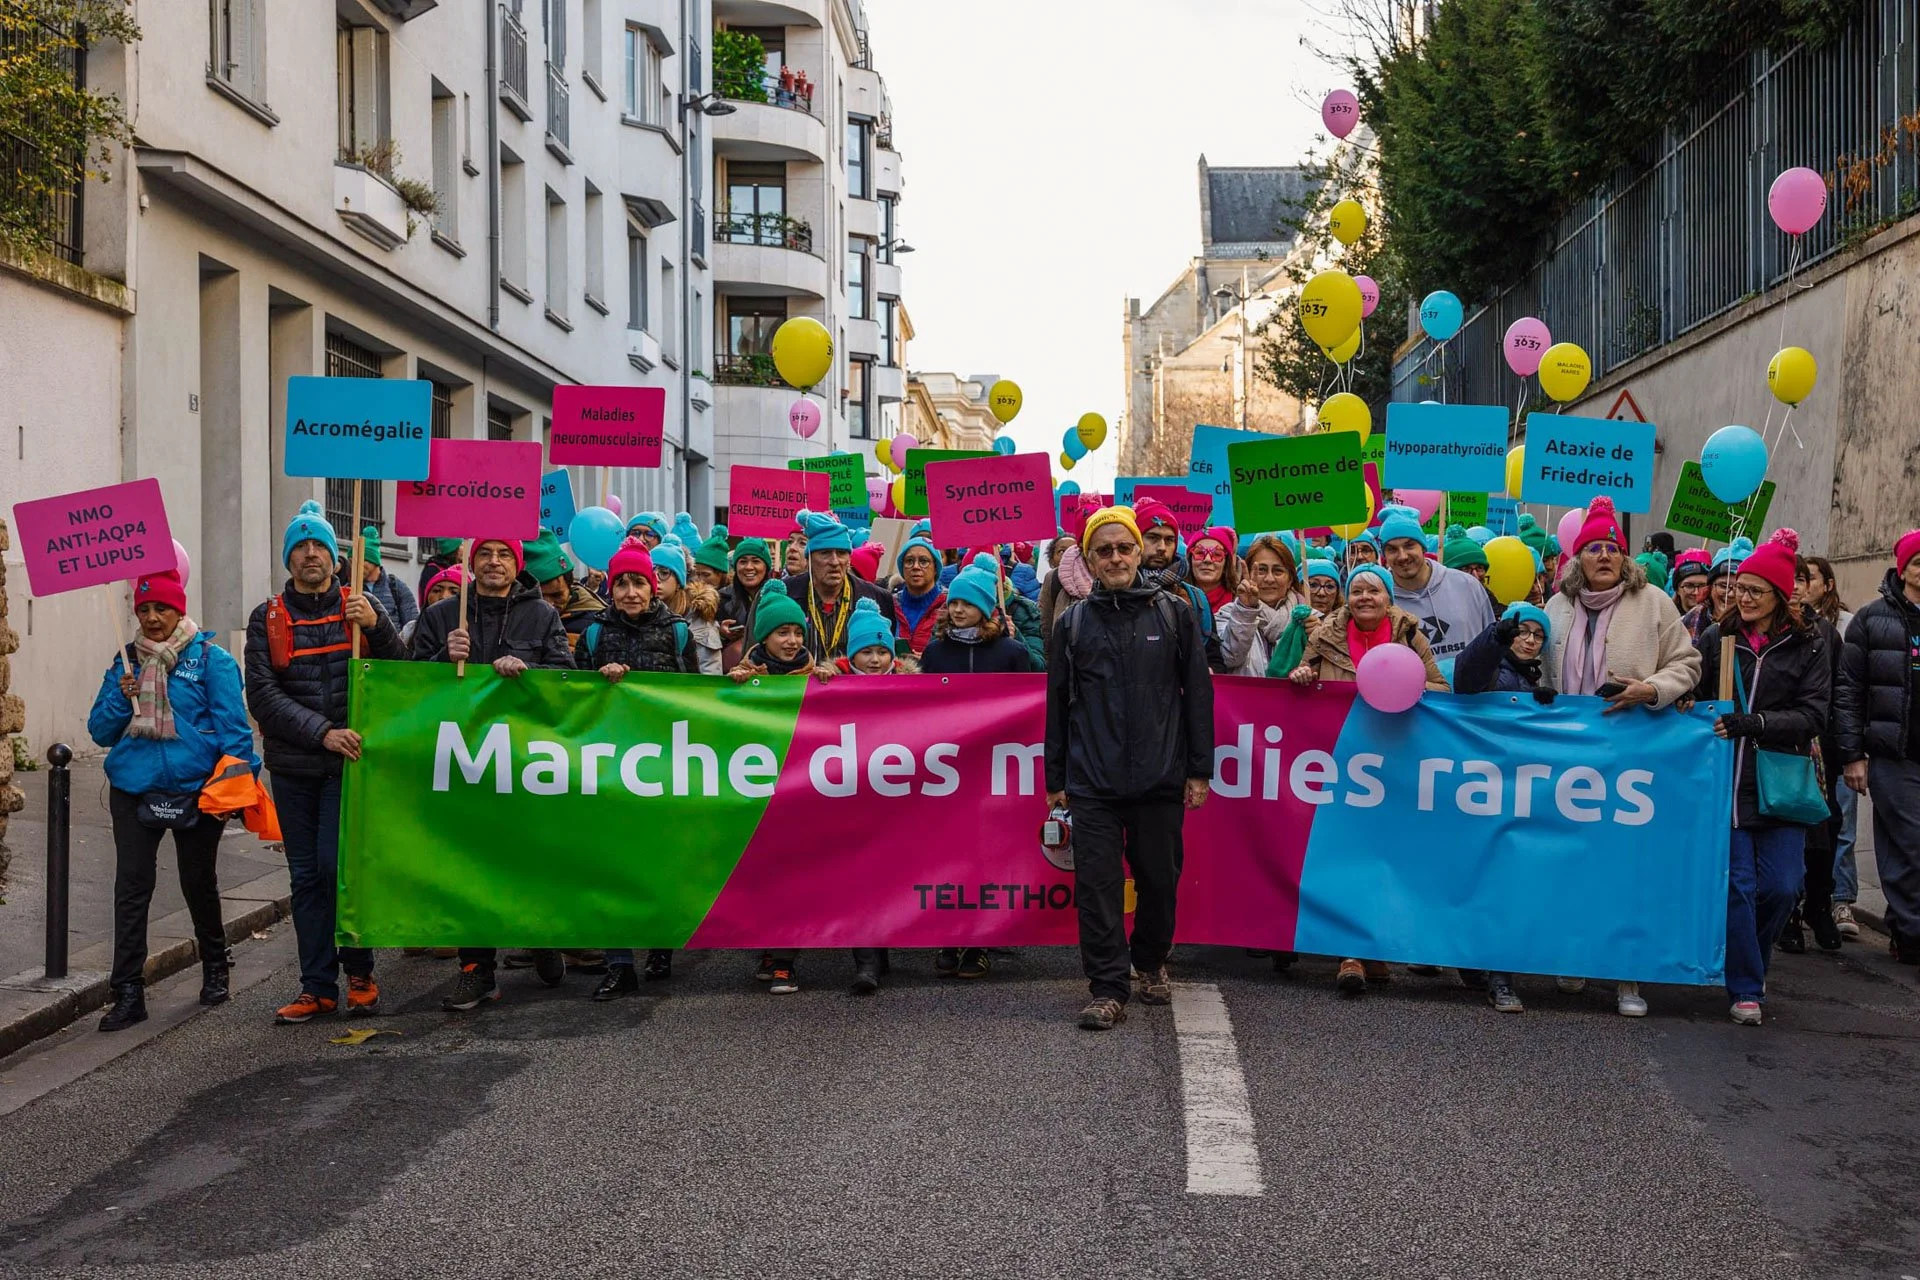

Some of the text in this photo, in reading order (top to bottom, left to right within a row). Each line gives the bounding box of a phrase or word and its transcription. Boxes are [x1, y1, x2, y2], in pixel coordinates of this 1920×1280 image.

[1362, 294, 1375, 303] 637
[1514, 338, 1541, 351] 3637
[581, 407, 635, 422] Maladies
[293, 418, 424, 441] Acromégalie
[553, 432, 660, 448] neuromusculaires
[1389, 440, 1504, 457] Hypoparathyroïdie
[1545, 439, 1634, 461] Ataxie de
[799, 457, 853, 470] SYNDROME
[1234, 456, 1358, 485] Syndrome de
[1541, 466, 1634, 489] Friedreich
[413, 480, 525, 499] Sarcoïdose
[752, 488, 793, 503] MALADIE
[945, 480, 1035, 501] Syndrome
[1274, 490, 1324, 507] Lowe
[68, 504, 113, 525] NMO
[731, 503, 797, 520] CREUTZFELDT-
[963, 505, 1023, 524] CDKL5
[1682, 515, 1704, 528] 800
[47, 521, 146, 554] ANTI-AQP4
[58, 545, 145, 575] ET LUPUS
[174, 670, 199, 681] PARIS
[432, 719, 1656, 826] Marche des mdies rares
